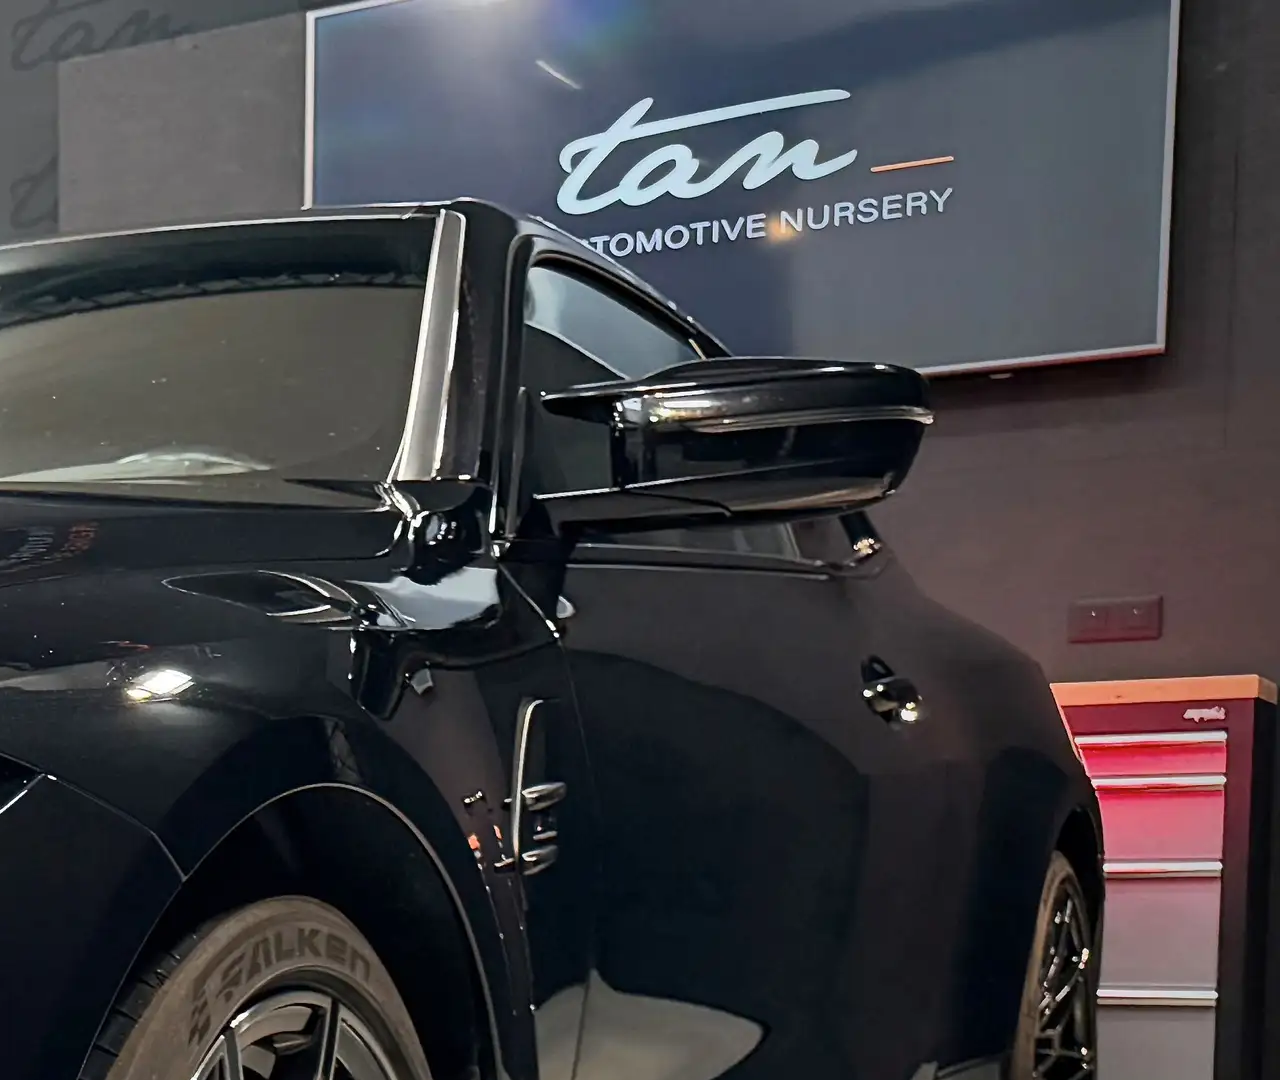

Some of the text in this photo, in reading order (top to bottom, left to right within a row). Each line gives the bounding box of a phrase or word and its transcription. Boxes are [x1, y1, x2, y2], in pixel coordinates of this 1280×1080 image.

[557, 89, 858, 215] tan
[586, 187, 953, 257] TOMOTIVE NURSERY
[216, 926, 371, 1003] FALKEN
